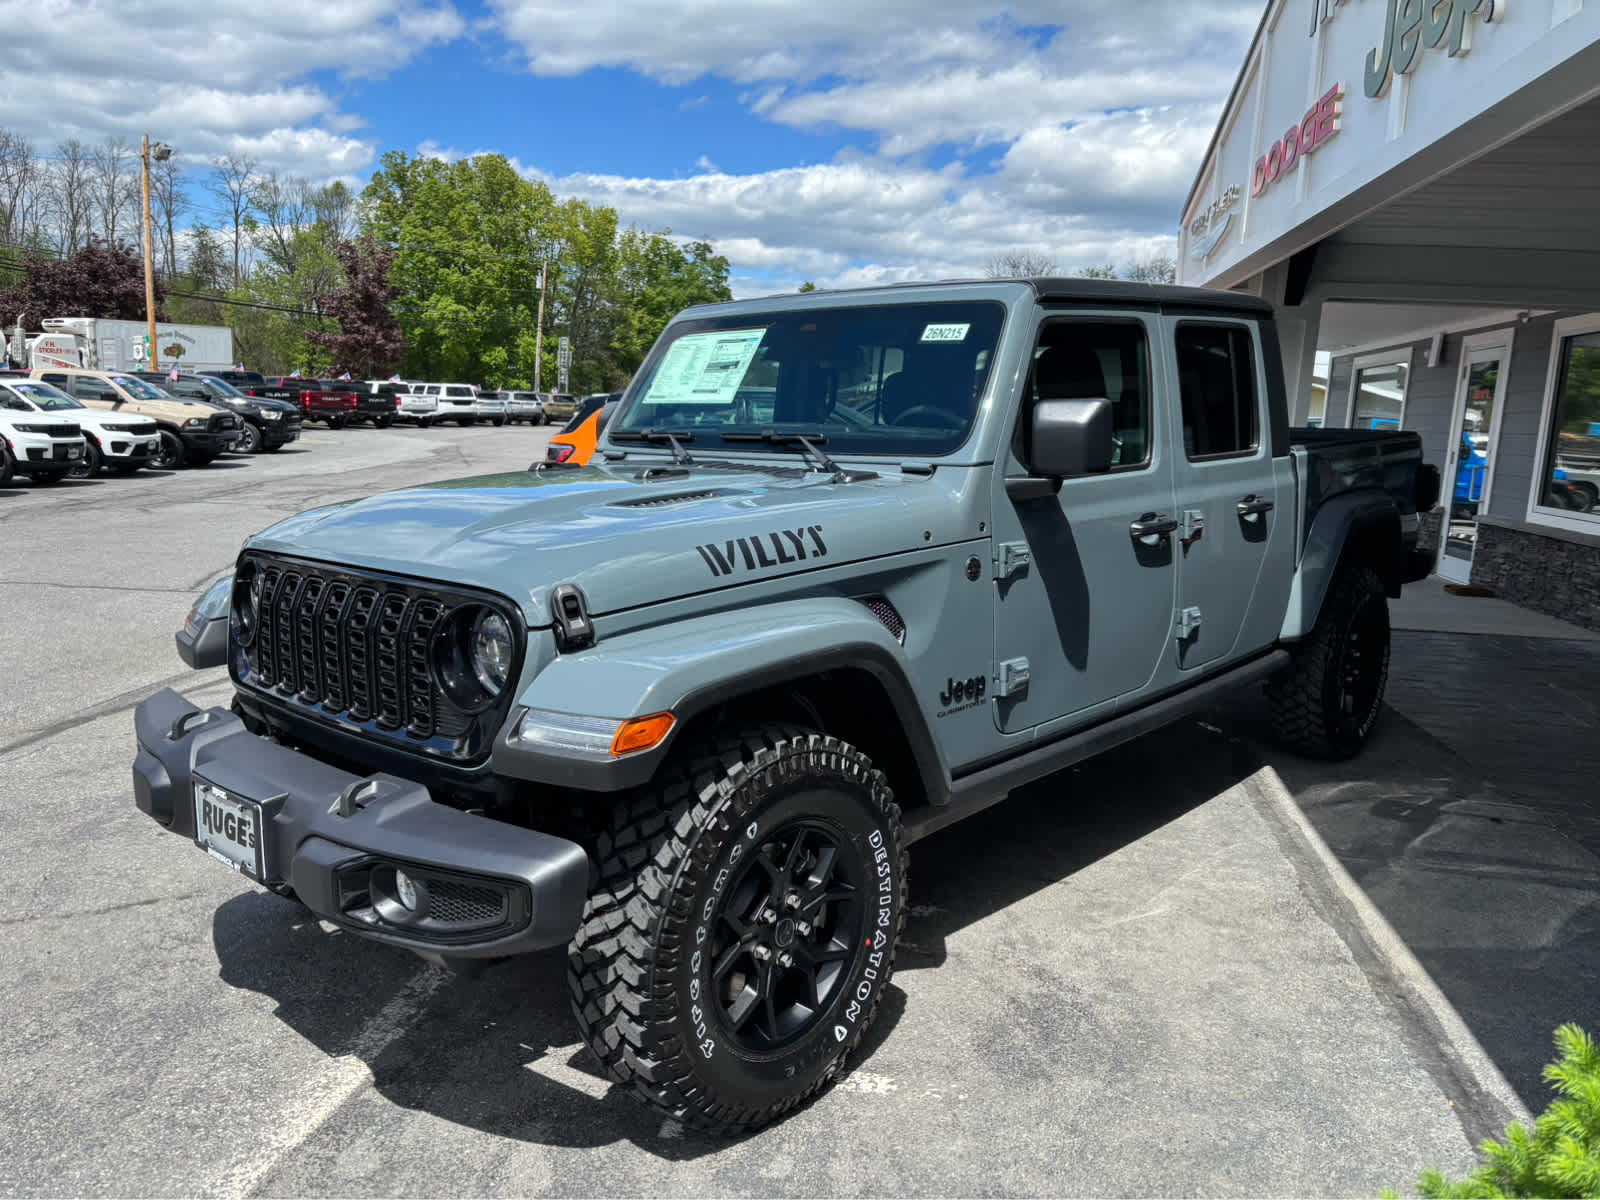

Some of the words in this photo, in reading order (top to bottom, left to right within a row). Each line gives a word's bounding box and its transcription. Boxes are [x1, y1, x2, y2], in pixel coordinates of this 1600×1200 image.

[1252, 81, 1340, 199] DODGE
[696, 525, 827, 576] WILLYS
[940, 675, 986, 706] Jeep
[845, 829, 893, 1024] DESTINATION
